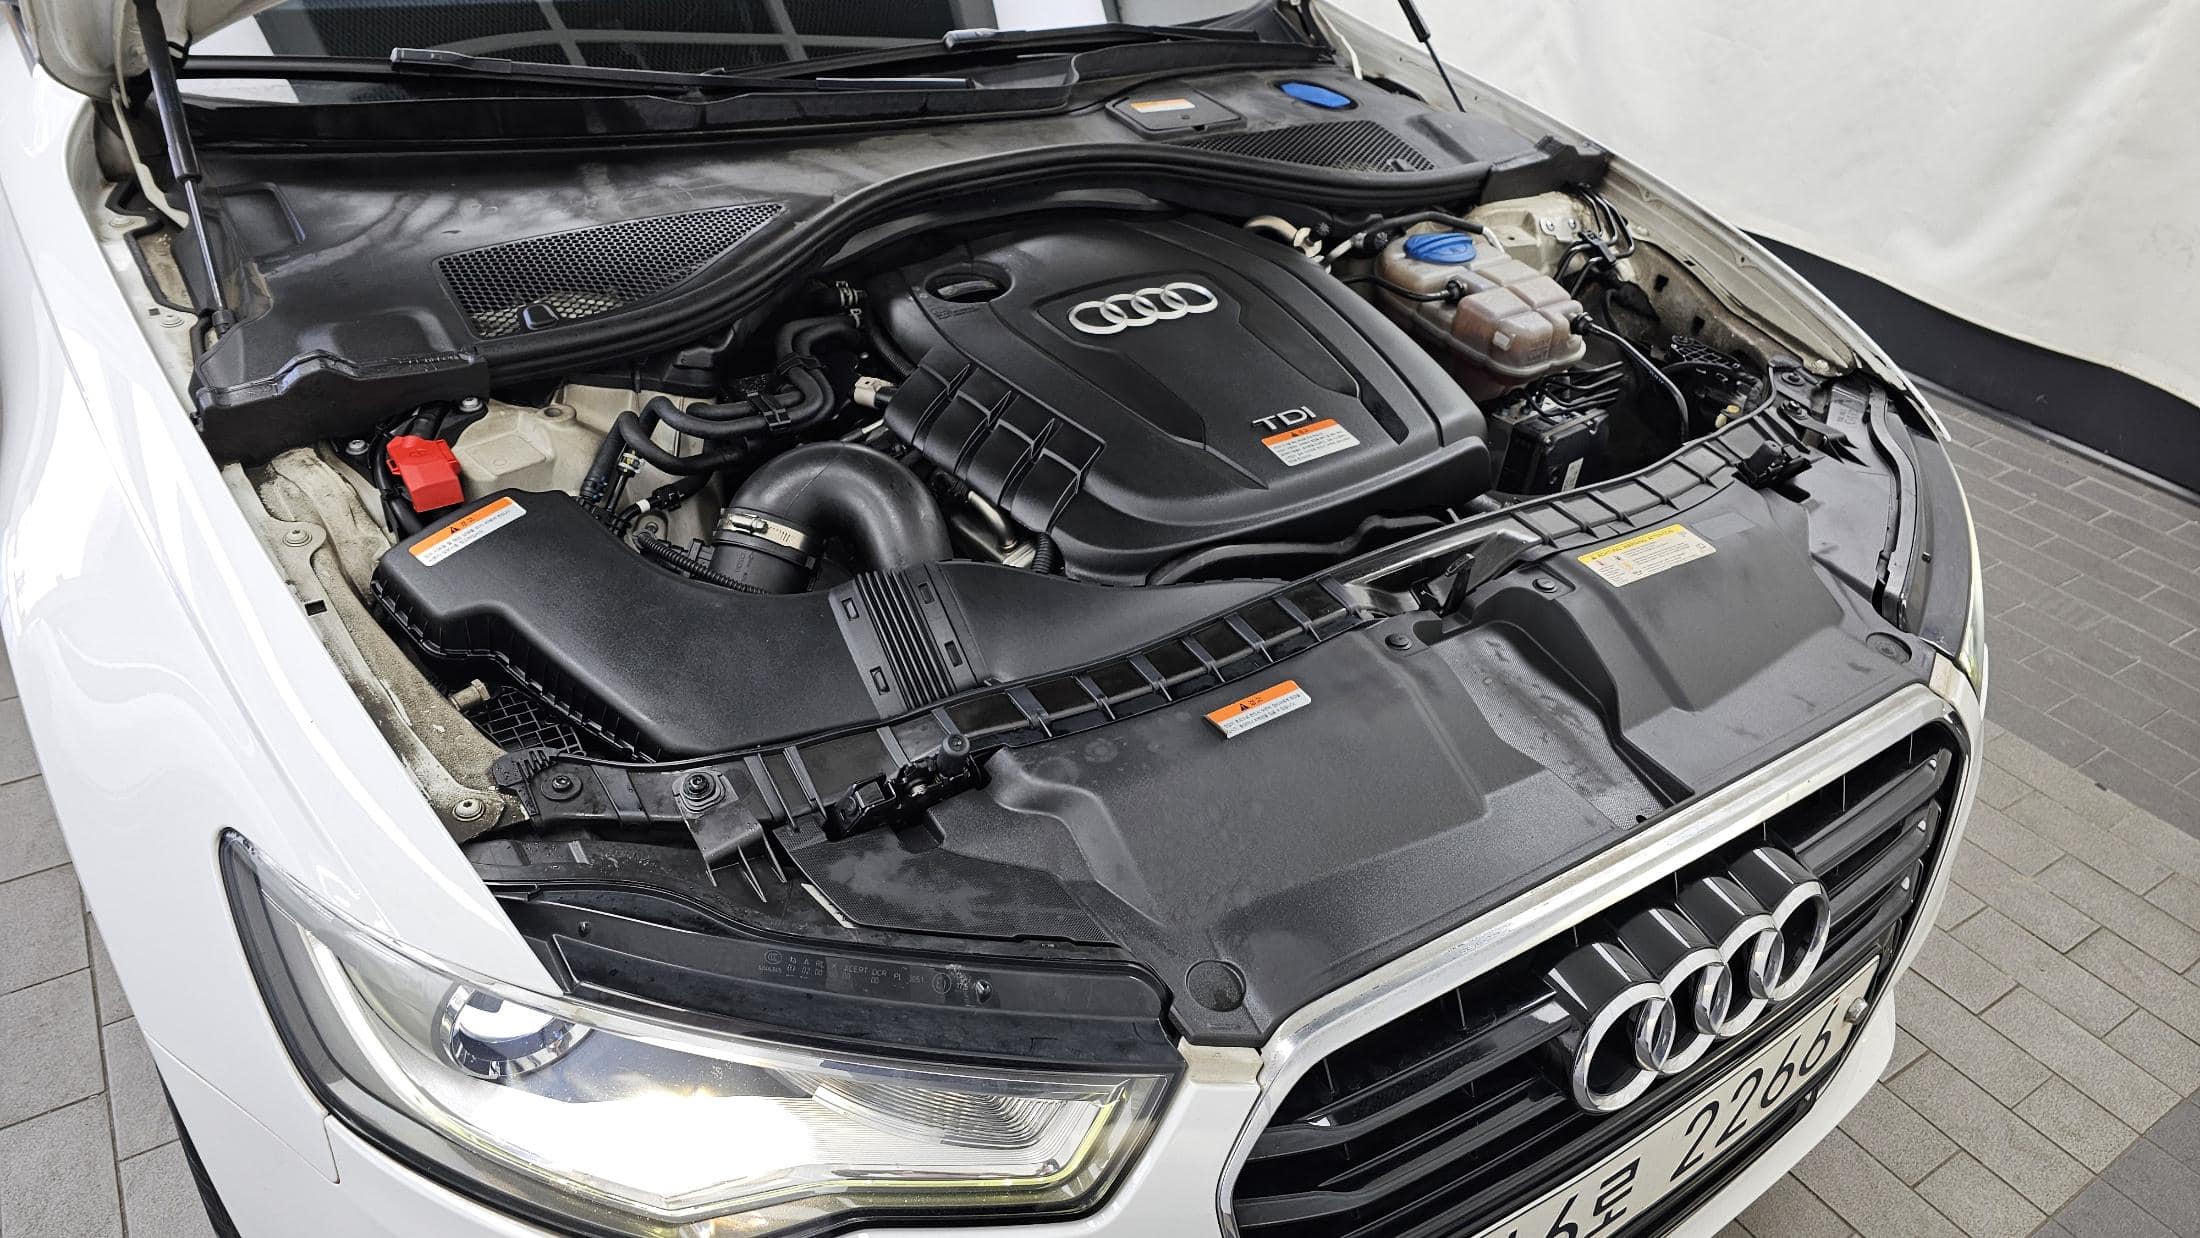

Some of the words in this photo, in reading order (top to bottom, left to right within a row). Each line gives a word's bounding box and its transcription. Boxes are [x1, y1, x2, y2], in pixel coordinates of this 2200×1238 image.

[1251, 405, 1317, 430] TDI
[1507, 1157, 1641, 1238] 6로
[1669, 1004, 1839, 1182] 2266
